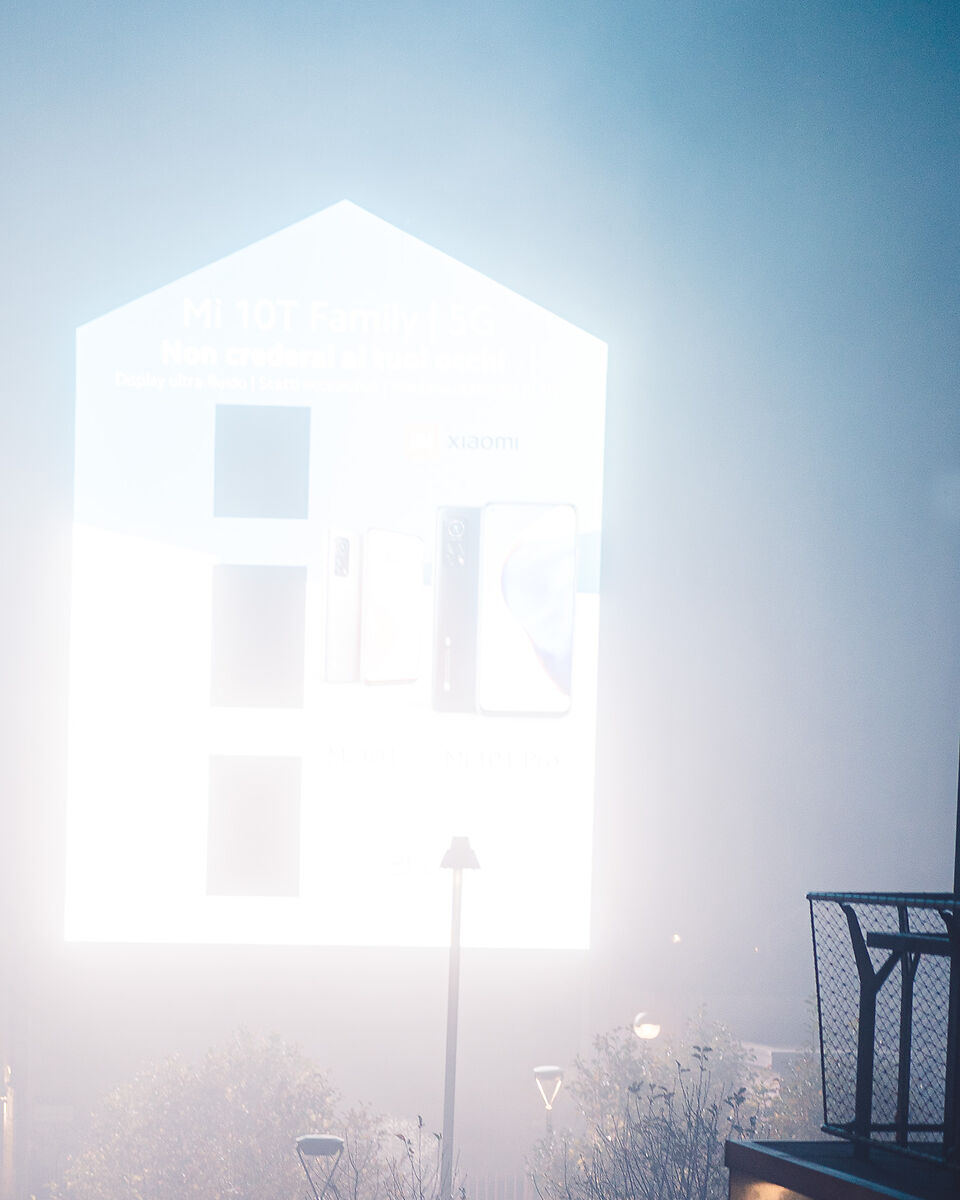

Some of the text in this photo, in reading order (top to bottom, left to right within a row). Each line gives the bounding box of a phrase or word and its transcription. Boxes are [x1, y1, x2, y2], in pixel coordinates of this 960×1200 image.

[182, 297, 223, 329] Mi
[233, 297, 299, 332] 10T
[309, 299, 418, 344] Family
[448, 303, 496, 337] 5G
[161, 337, 217, 367] Non
[448, 432, 519, 450] xiaomi
